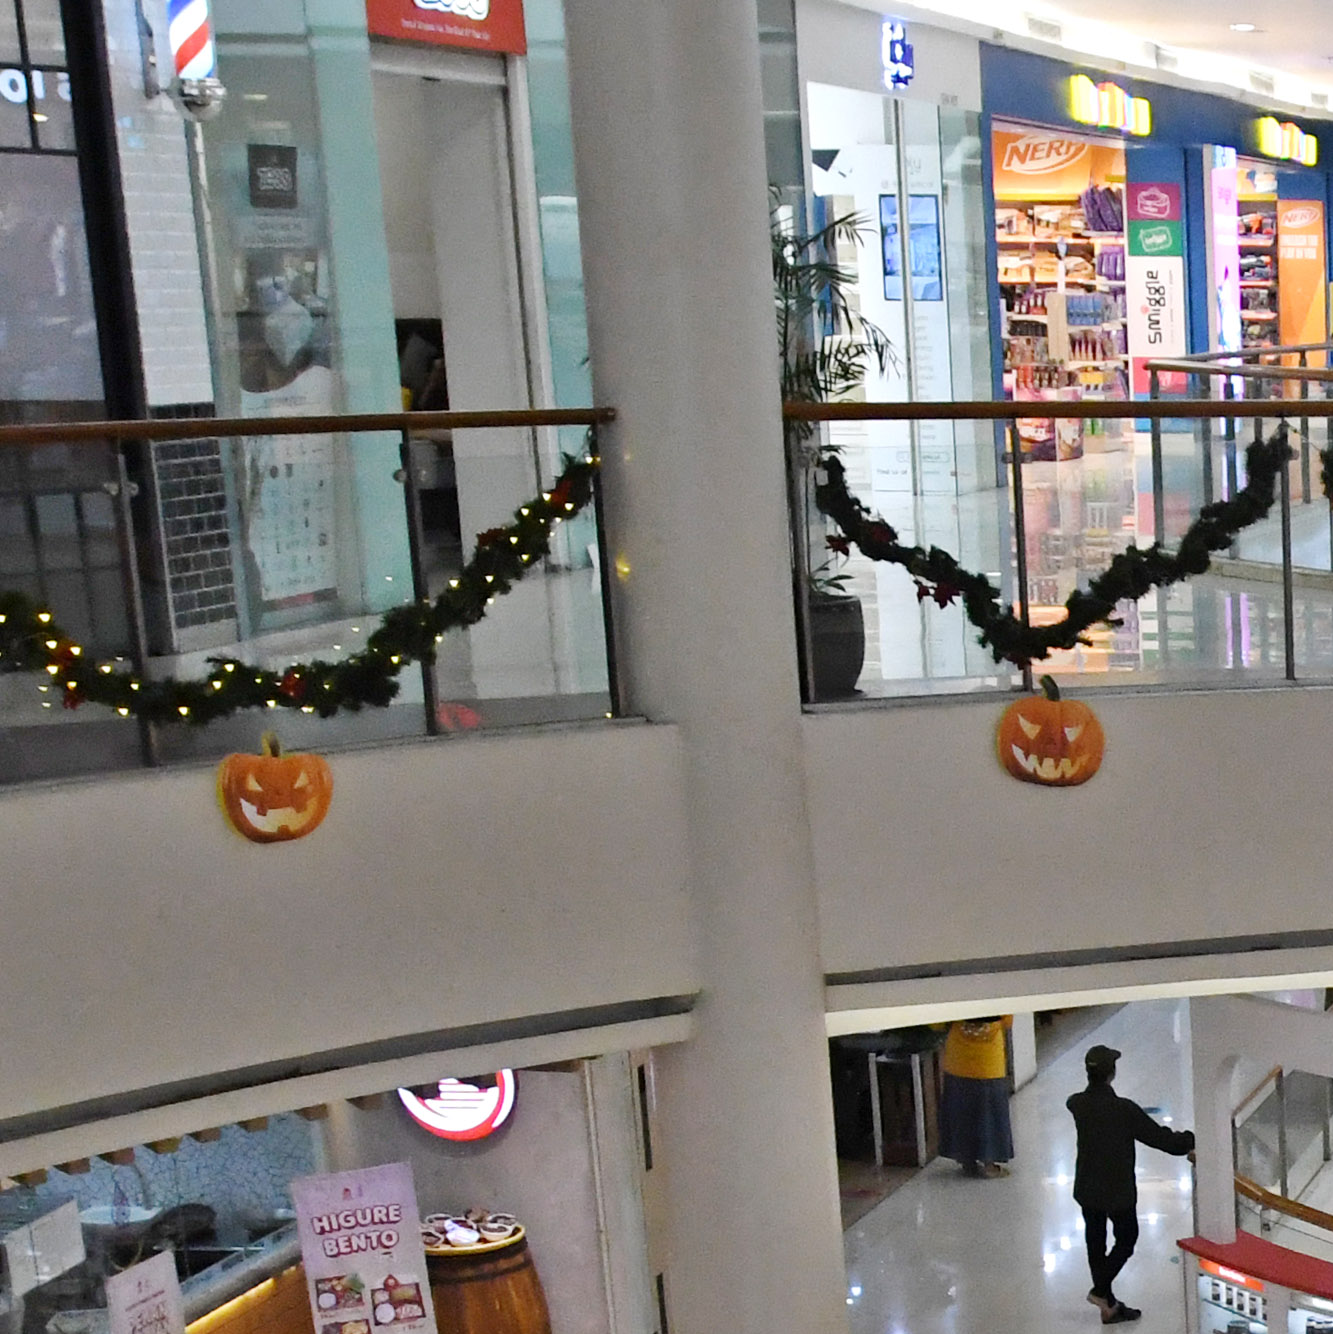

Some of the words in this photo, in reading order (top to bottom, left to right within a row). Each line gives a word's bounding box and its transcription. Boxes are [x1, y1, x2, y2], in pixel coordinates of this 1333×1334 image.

[1141, 269, 1166, 344] smiggle
[312, 1203, 402, 1235] HIGURE
[322, 1229, 399, 1258] BENTO
